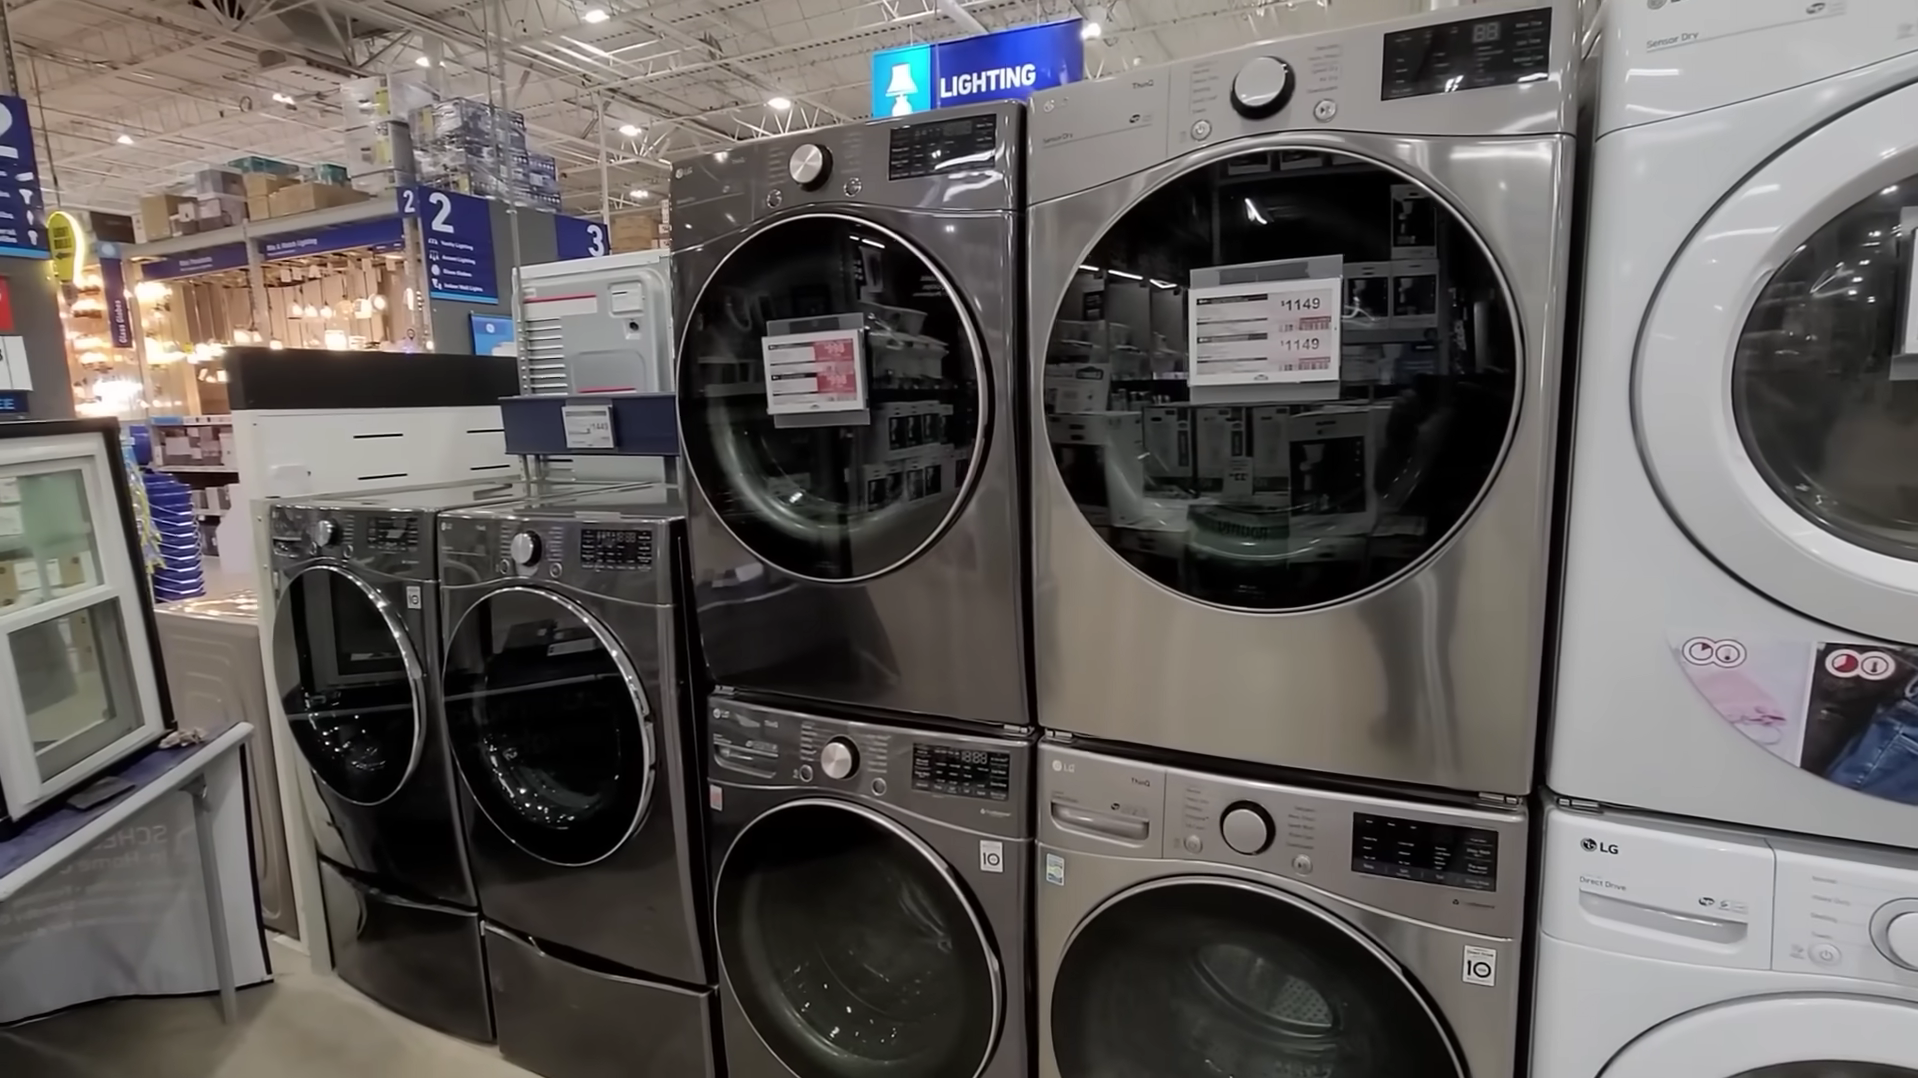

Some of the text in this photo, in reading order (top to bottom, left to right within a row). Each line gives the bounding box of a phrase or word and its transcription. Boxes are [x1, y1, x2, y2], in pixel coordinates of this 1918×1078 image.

[1646, 31, 1699, 49] Sensor Dry
[940, 63, 1037, 98] LIGHTING
[403, 190, 416, 213] 2
[428, 192, 455, 234] 2
[587, 224, 605, 258] 3
[1281, 297, 1321, 311] $1149
[118, 324, 128, 344] Glass
[1063, 763, 1075, 773] LG
[1600, 842, 1619, 855] LG
[983, 852, 1000, 866] 10
[1579, 876, 1627, 892] Direct Drive
[1467, 960, 1492, 978] 10
